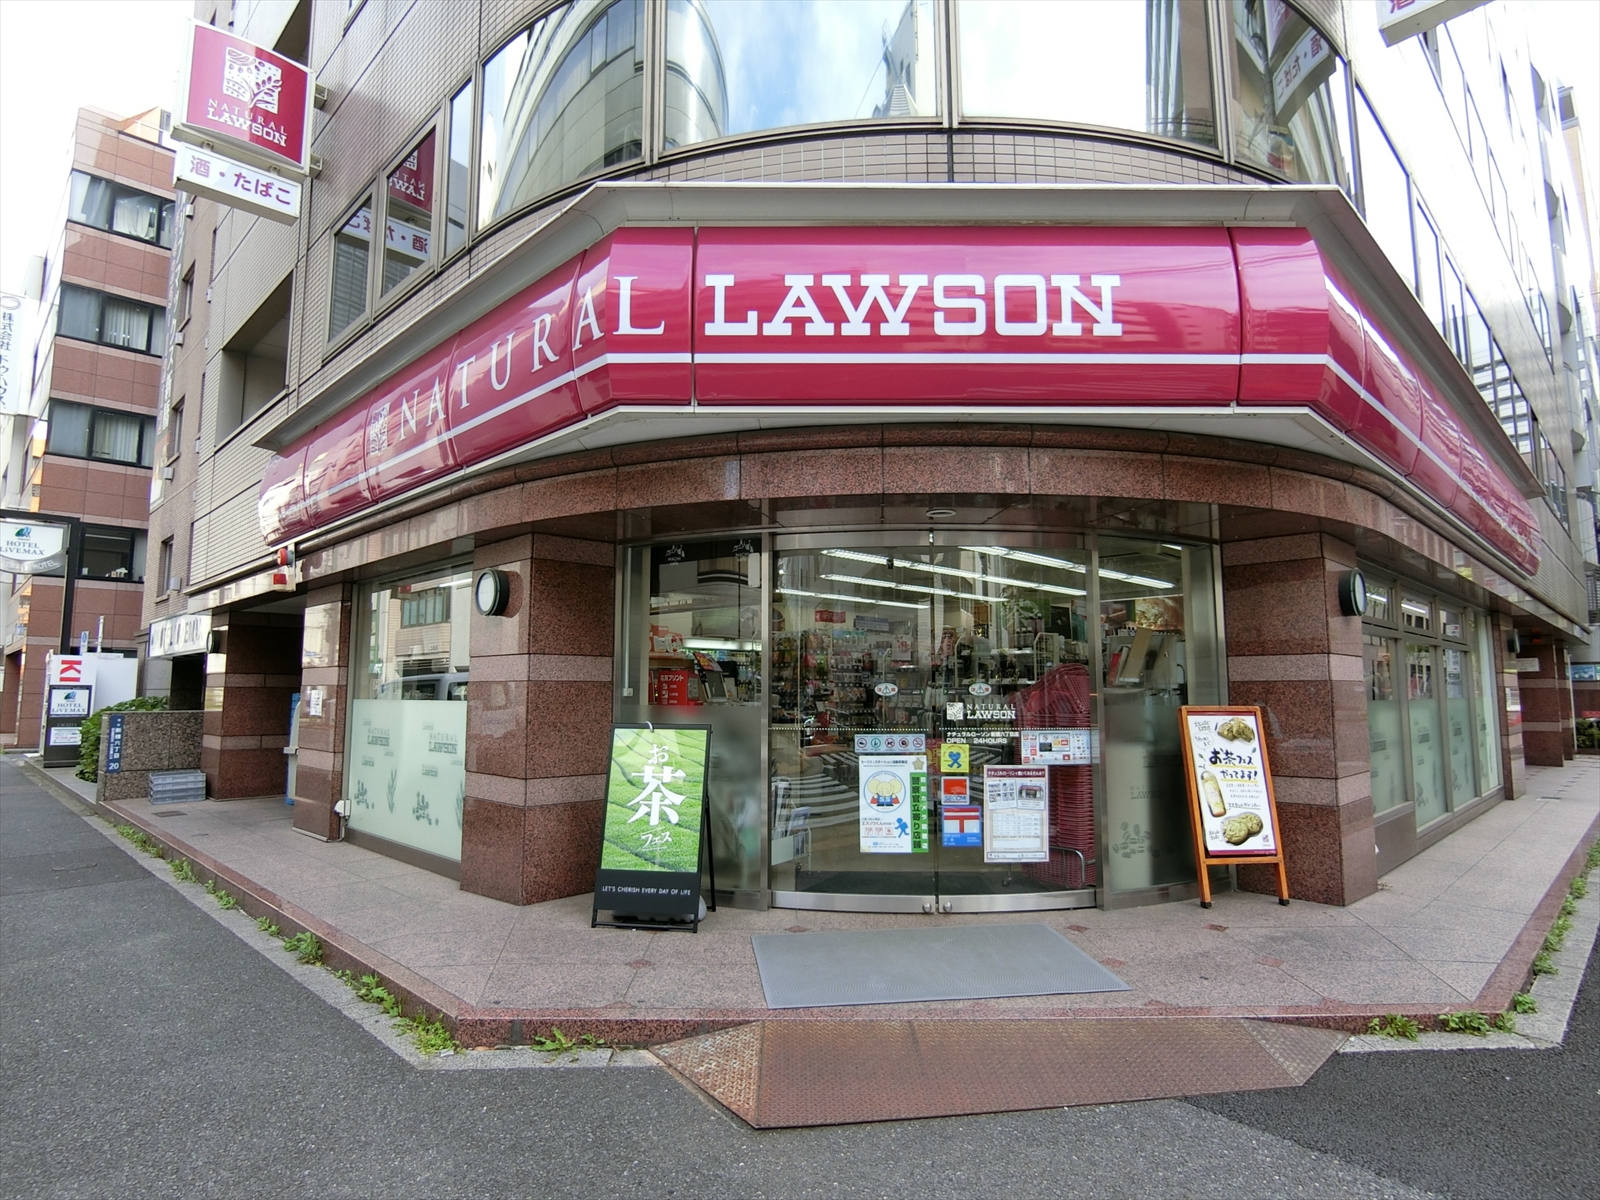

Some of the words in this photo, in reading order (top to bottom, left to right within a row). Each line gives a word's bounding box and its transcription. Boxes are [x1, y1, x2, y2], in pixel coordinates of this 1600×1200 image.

[208, 98, 288, 135] NATURAL
[207, 107, 287, 147] LAWSON
[190, 155, 291, 205] 酒・たばこ
[399, 276, 665, 441] NATURAL
[704, 274, 1123, 336] LAWSON
[6, 540, 40, 549] HOTEL
[966, 710, 1016, 719] LAWSON
[367, 735, 390, 747] LAWSON
[428, 741, 458, 754] LAWSON
[1209, 747, 1254, 767] お茶フェス
[109, 762, 120, 770] 20
[641, 831, 672, 848] フェス
